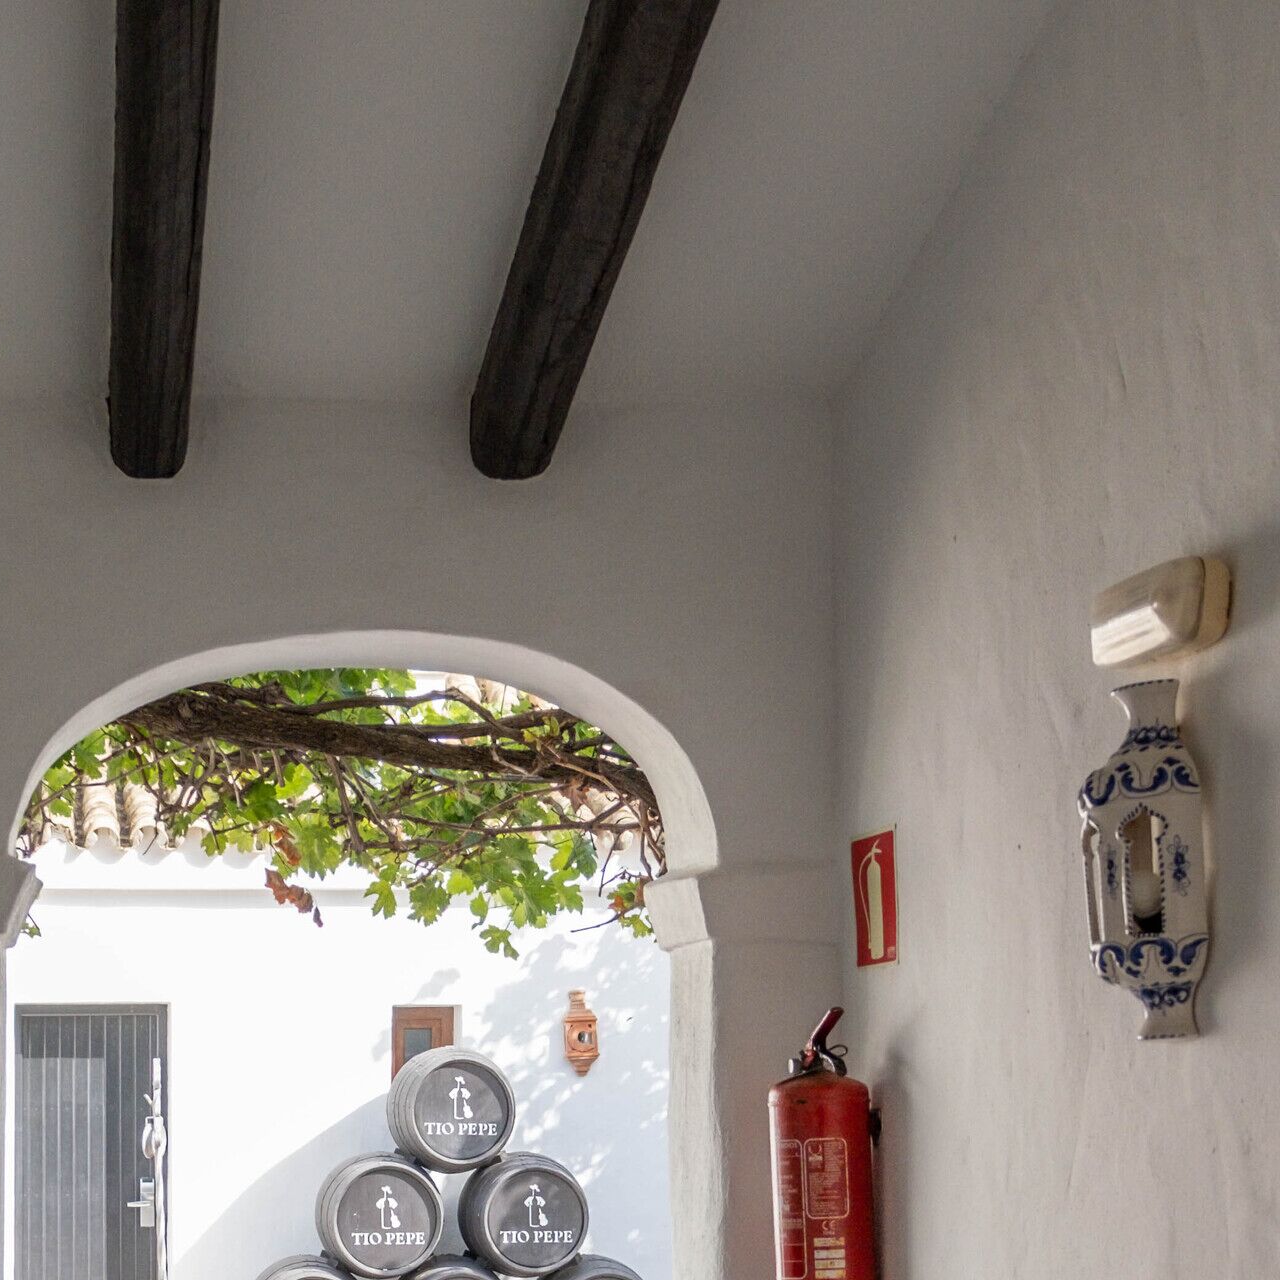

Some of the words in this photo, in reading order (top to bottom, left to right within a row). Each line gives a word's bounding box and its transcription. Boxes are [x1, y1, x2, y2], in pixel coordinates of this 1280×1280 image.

[424, 1122, 455, 1136] TIO
[458, 1122, 498, 1137] PEPE
[351, 1232, 382, 1246] TIO
[384, 1231, 426, 1246] PEPE
[499, 1230, 530, 1244] TIO
[532, 1230, 573, 1244] PEPE
